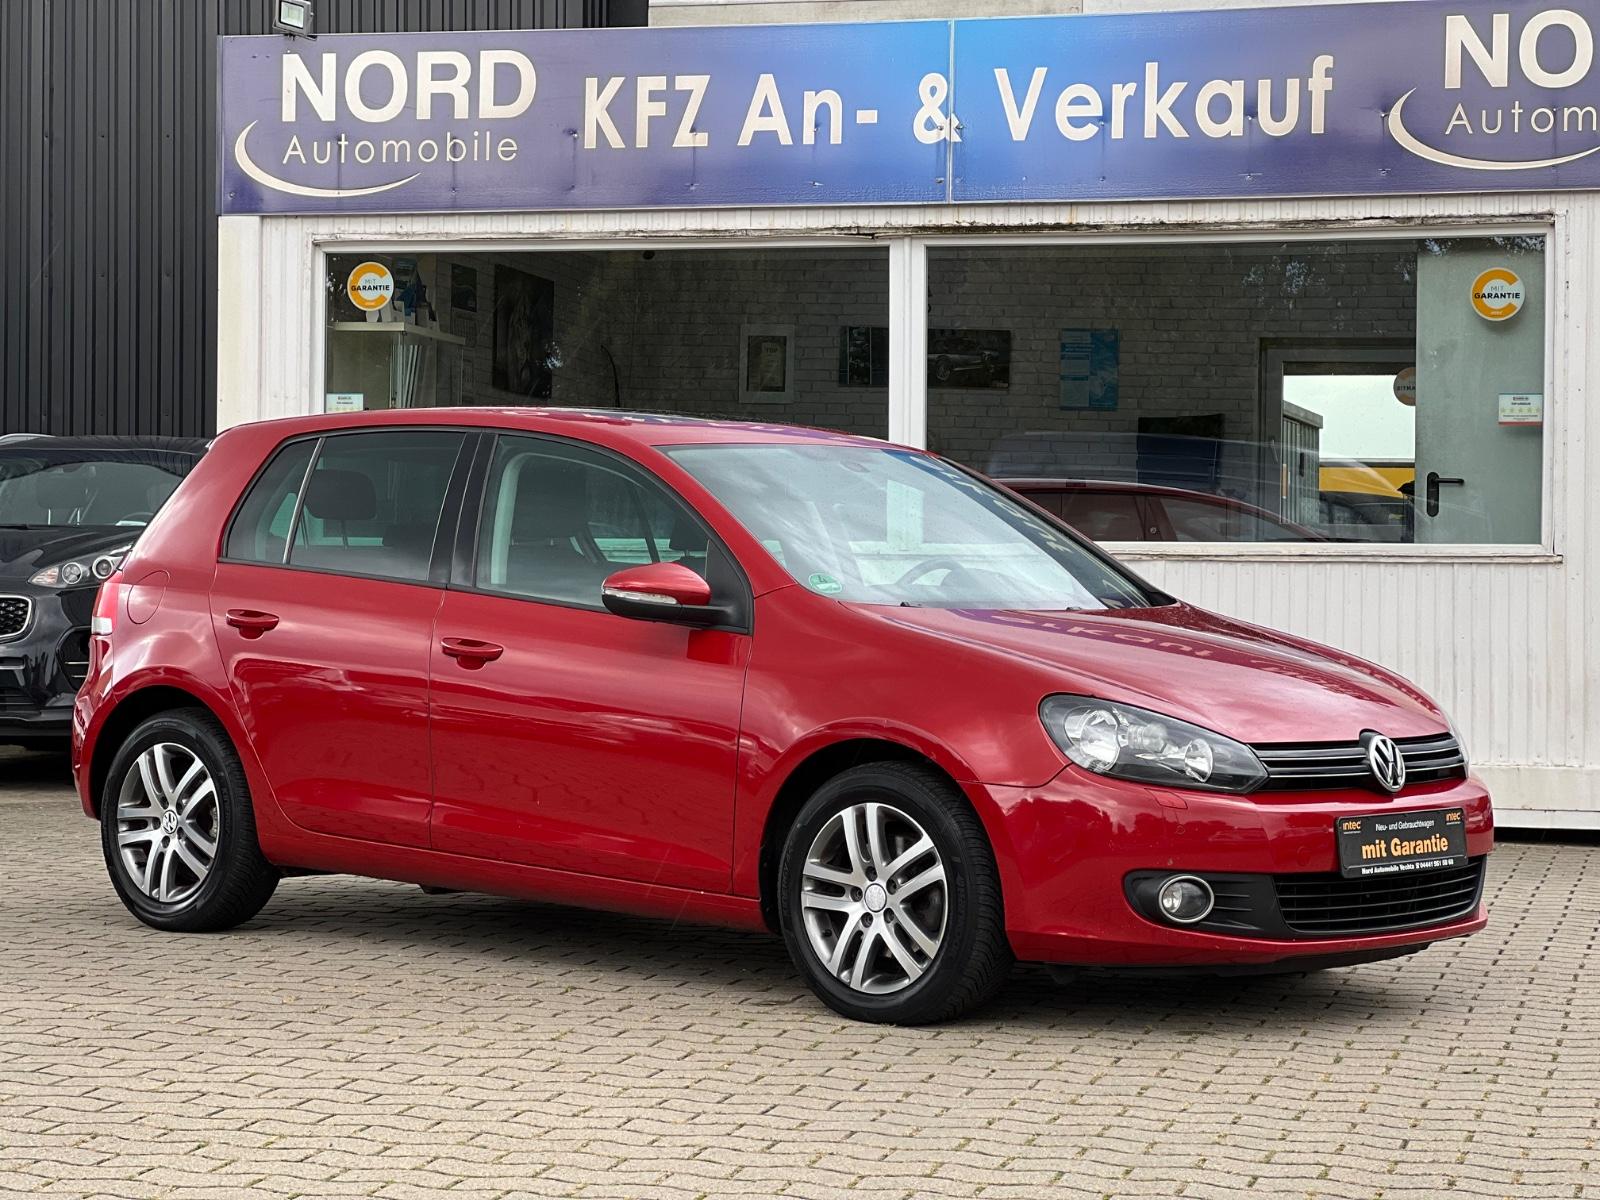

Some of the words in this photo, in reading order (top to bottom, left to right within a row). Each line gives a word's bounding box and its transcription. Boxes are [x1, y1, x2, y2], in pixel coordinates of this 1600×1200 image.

[1445, 9, 1594, 89] NO
[281, 50, 537, 123] NORD
[583, 74, 710, 150] KFZ
[737, 73, 879, 147] An-
[912, 72, 962, 144] &
[993, 54, 1335, 142] Verkauf
[1444, 100, 1597, 135] Autom
[282, 131, 519, 165] Automobile
[1343, 820, 1361, 830] intec
[1375, 822, 1388, 832] Neu-
[1388, 821, 1398, 830] und
[1398, 819, 1435, 830] Gebrauchtwagen
[1361, 839, 1387, 859] mit
[1391, 833, 1448, 856] Garantie
[1361, 866, 1374, 875] Nord
[1374, 864, 1399, 873] Automobile
